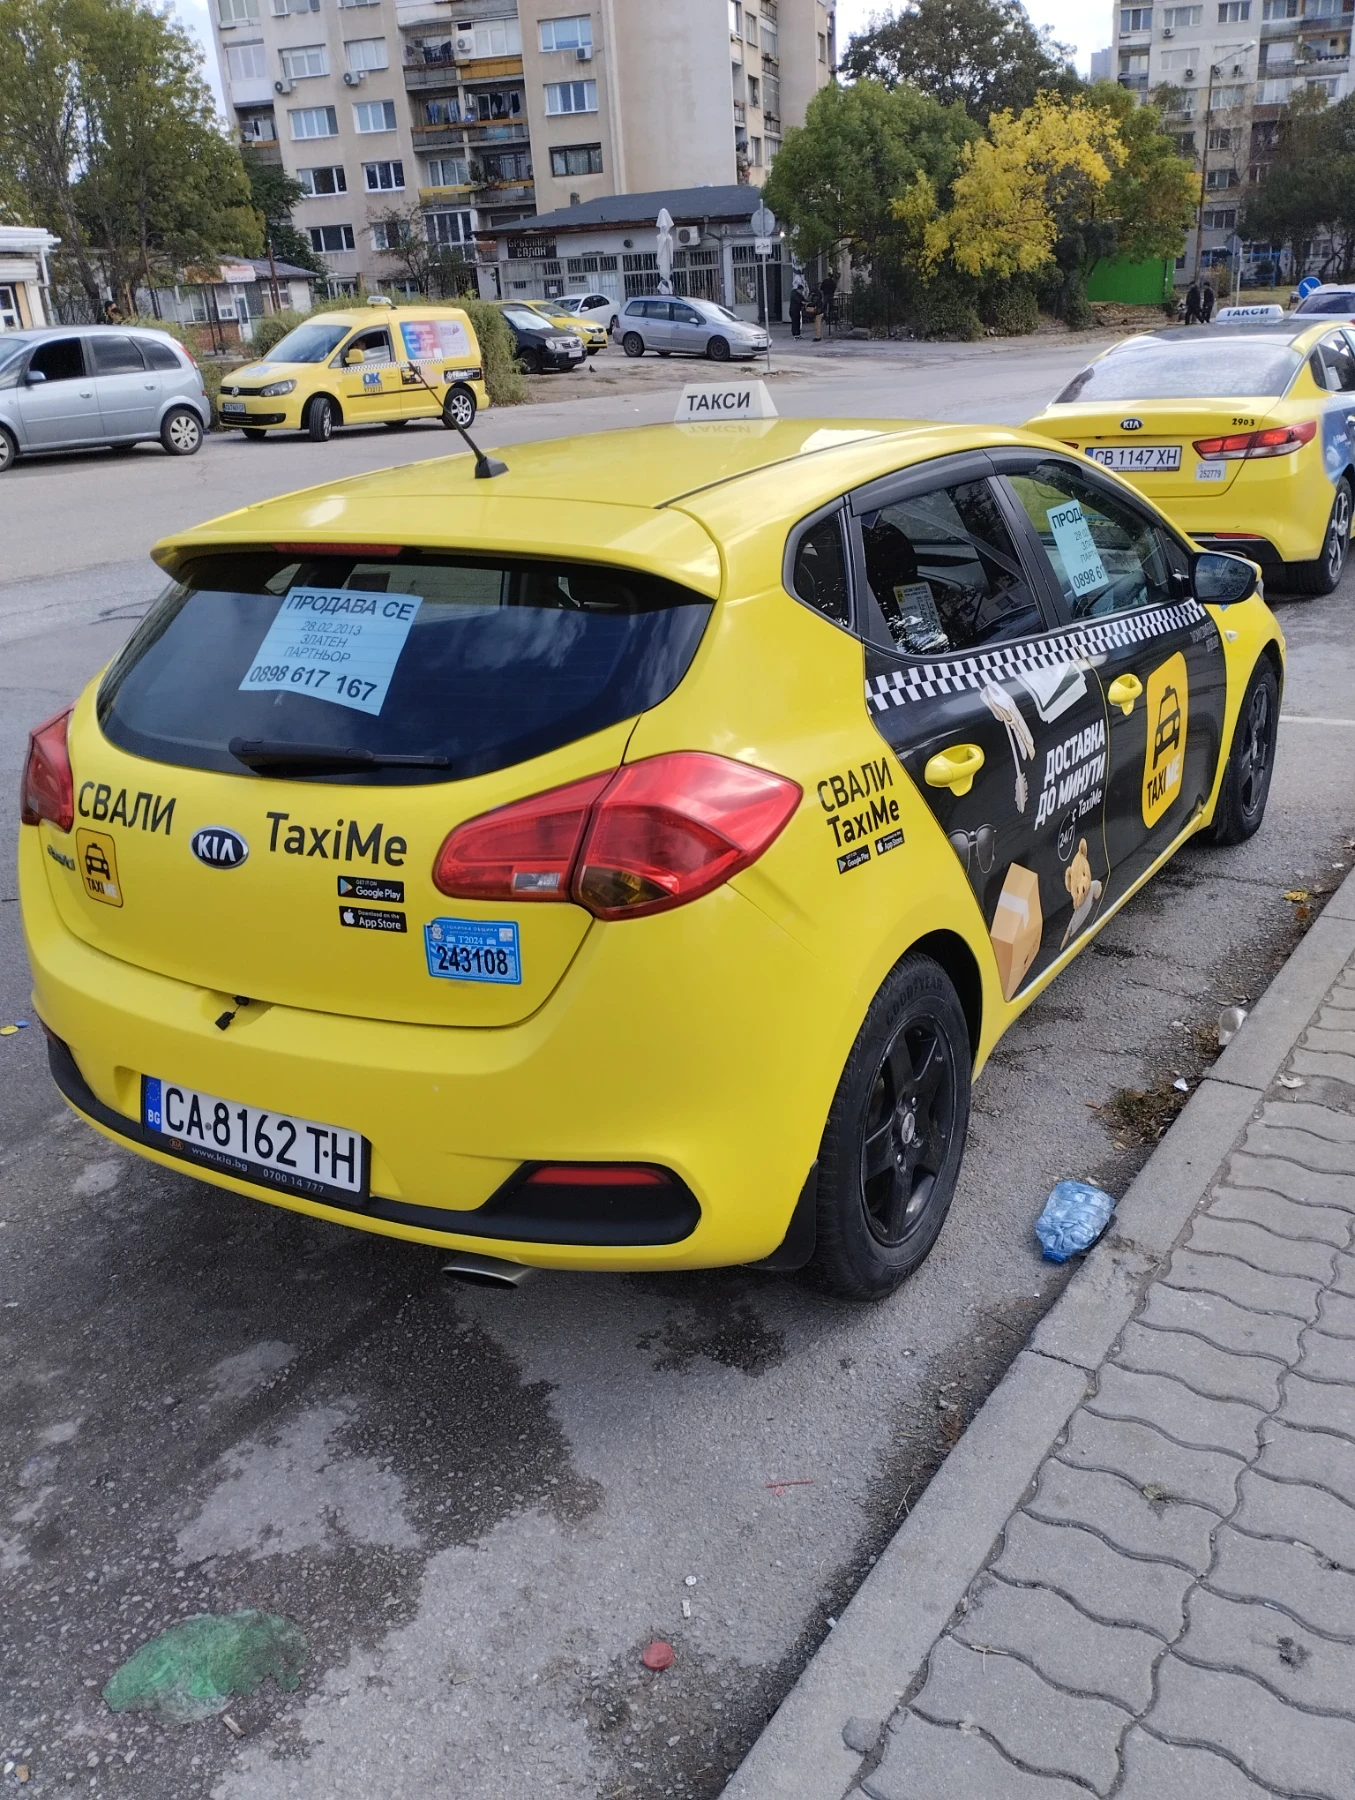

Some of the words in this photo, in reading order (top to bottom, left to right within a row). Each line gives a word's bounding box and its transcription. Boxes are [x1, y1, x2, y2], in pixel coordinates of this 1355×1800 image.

[517, 246, 547, 258] САЛОН
[1226, 307, 1270, 317] ТАКСИ
[362, 371, 382, 385] OK
[686, 391, 751, 412] ТАКСИ
[1122, 419, 1141, 429] KIA
[1232, 418, 1255, 427] 2903
[1095, 450, 1114, 466] CB
[1119, 449, 1154, 465] 1147
[1156, 449, 1178, 465] XH
[1199, 469, 1222, 479] 252779
[1072, 568, 1096, 590] 0898
[286, 595, 377, 615] ПРОДАВА
[382, 601, 415, 621] СЕ
[301, 621, 363, 636] 28.02.2013
[300, 634, 349, 648] ЗЛАТЕН
[284, 646, 352, 664] ПАРТНЬОР
[249, 665, 290, 683] 0898
[290, 667, 331, 688] 617
[336, 675, 378, 702] 167
[1044, 718, 1106, 790] ДОСТАВКА
[816, 756, 894, 813] СВАЛИ
[1034, 785, 1057, 831] ДО
[1057, 752, 1107, 810] МИНУТИ
[1146, 753, 1182, 809] TAXIME
[77, 780, 178, 836] СВАЛИ
[1078, 787, 1103, 818] TaxiMe
[826, 795, 900, 848] TaxiMe
[266, 811, 408, 867] TaxiMe
[1059, 824, 1075, 849] 24/7
[197, 834, 237, 863] KIA
[86, 876, 119, 900] TAXIME
[355, 885, 384, 899] Google
[384, 888, 401, 901] Play
[358, 909, 383, 918] Download
[359, 916, 377, 929] App
[377, 918, 402, 930] Store
[457, 935, 484, 945] T2024
[436, 945, 508, 976] 243108
[147, 1108, 161, 1125] BG
[165, 1087, 205, 1141] CA
[212, 1102, 297, 1168] 8162
[170, 1139, 184, 1150] KIA
[191, 1147, 249, 1173] www.kia.bg
[262, 1168, 288, 1184] 0700
[290, 1174, 303, 1188] 14
[305, 1181, 325, 1194] 777
